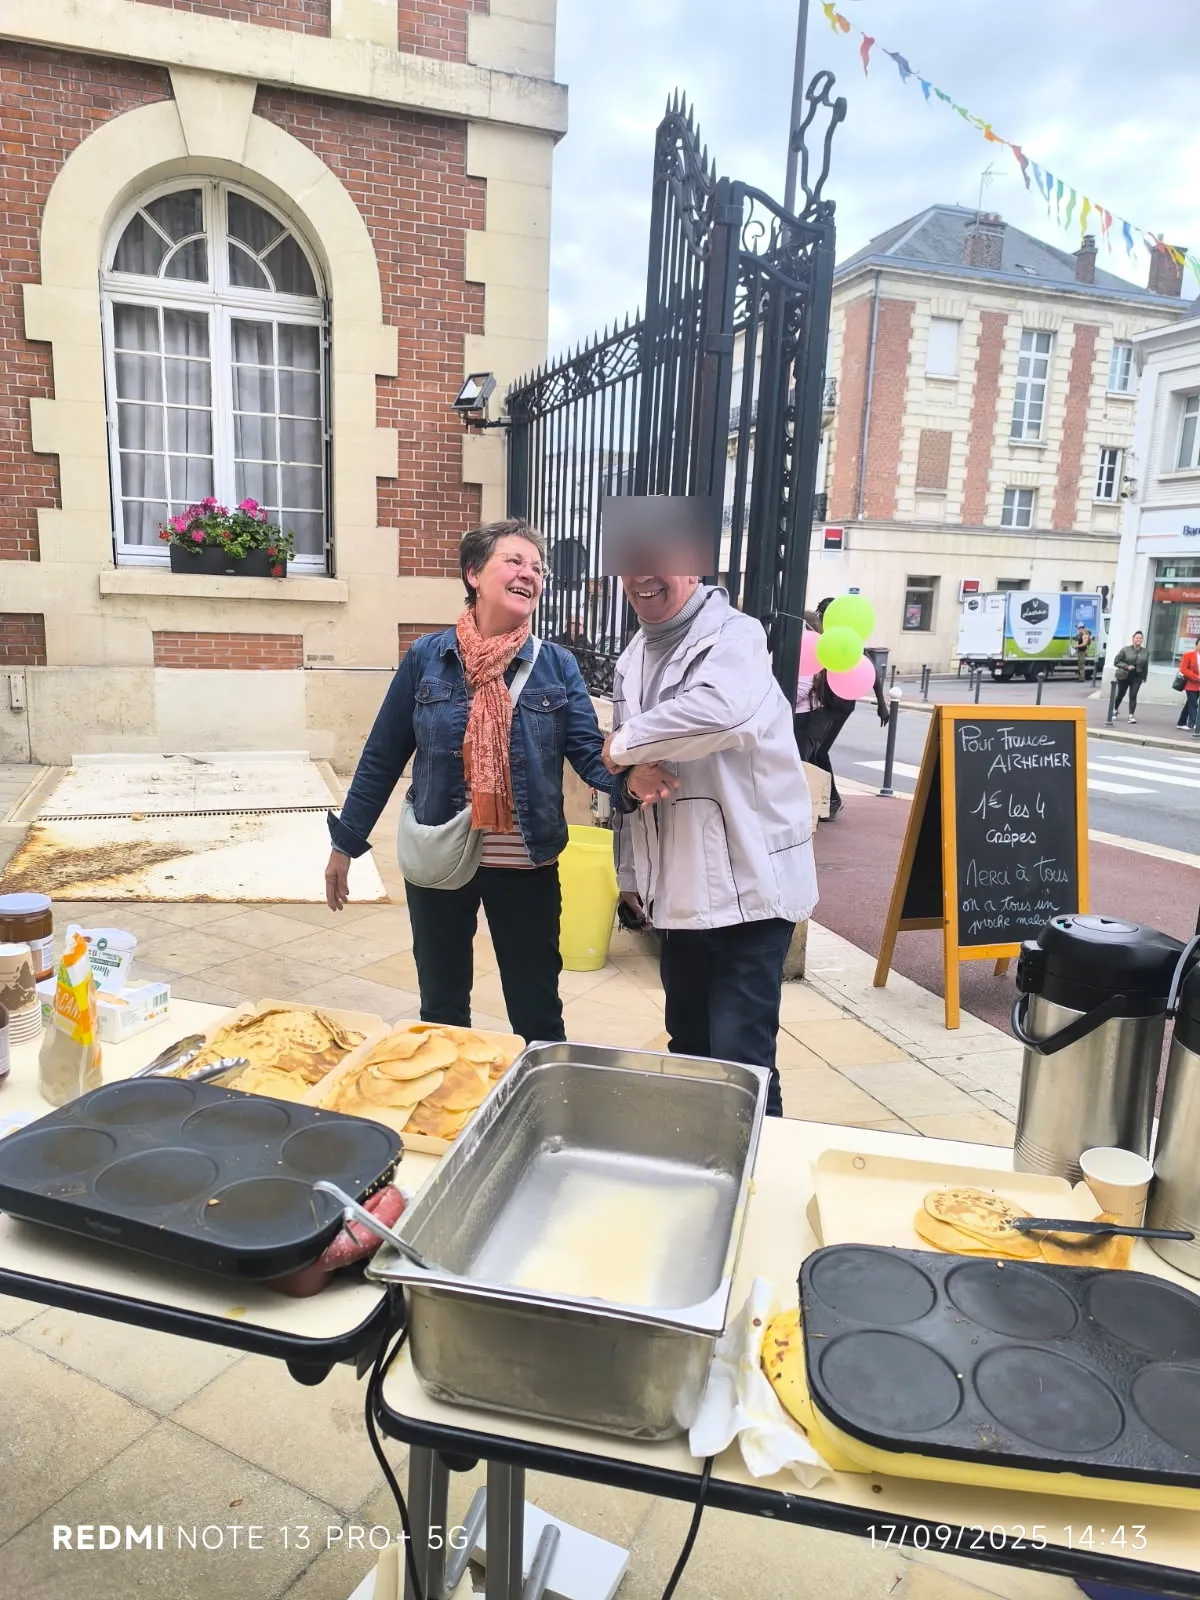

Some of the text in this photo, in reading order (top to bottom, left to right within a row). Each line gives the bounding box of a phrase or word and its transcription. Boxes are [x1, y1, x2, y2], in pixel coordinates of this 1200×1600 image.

[958, 725, 1056, 752] Pour France
[970, 789, 1046, 820] 1€ les 4
[1015, 863, 1031, 882] à
[984, 900, 997, 912] a
[1001, 895, 1031, 912] tous
[1034, 899, 1060, 911] un
[968, 914, 1010, 935] proche
